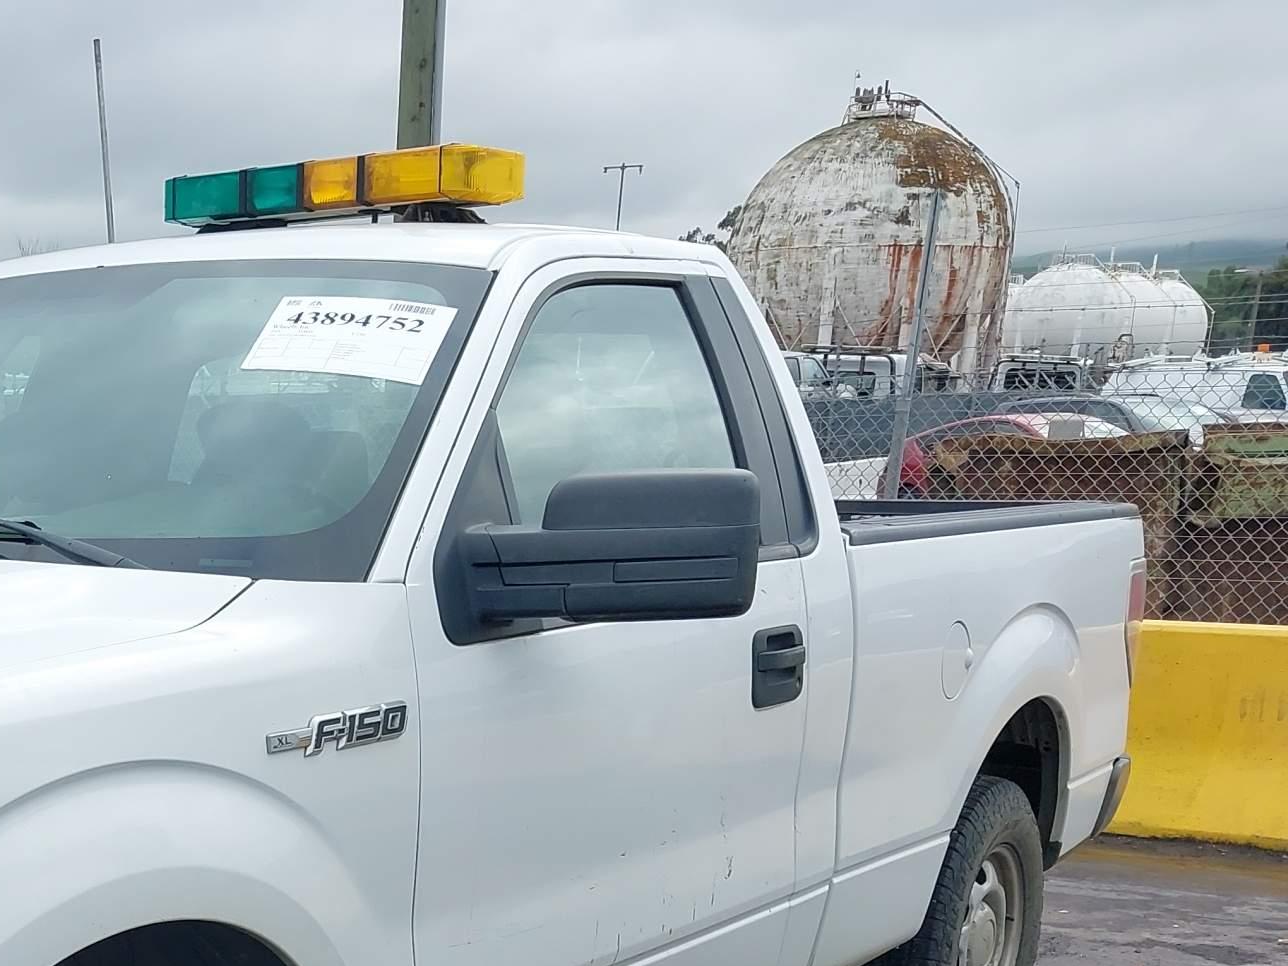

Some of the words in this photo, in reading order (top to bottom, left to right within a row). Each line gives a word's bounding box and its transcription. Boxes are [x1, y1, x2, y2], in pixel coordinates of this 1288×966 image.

[286, 311, 425, 333] 43894752
[275, 736, 293, 746] XL
[304, 701, 408, 757] F-150
